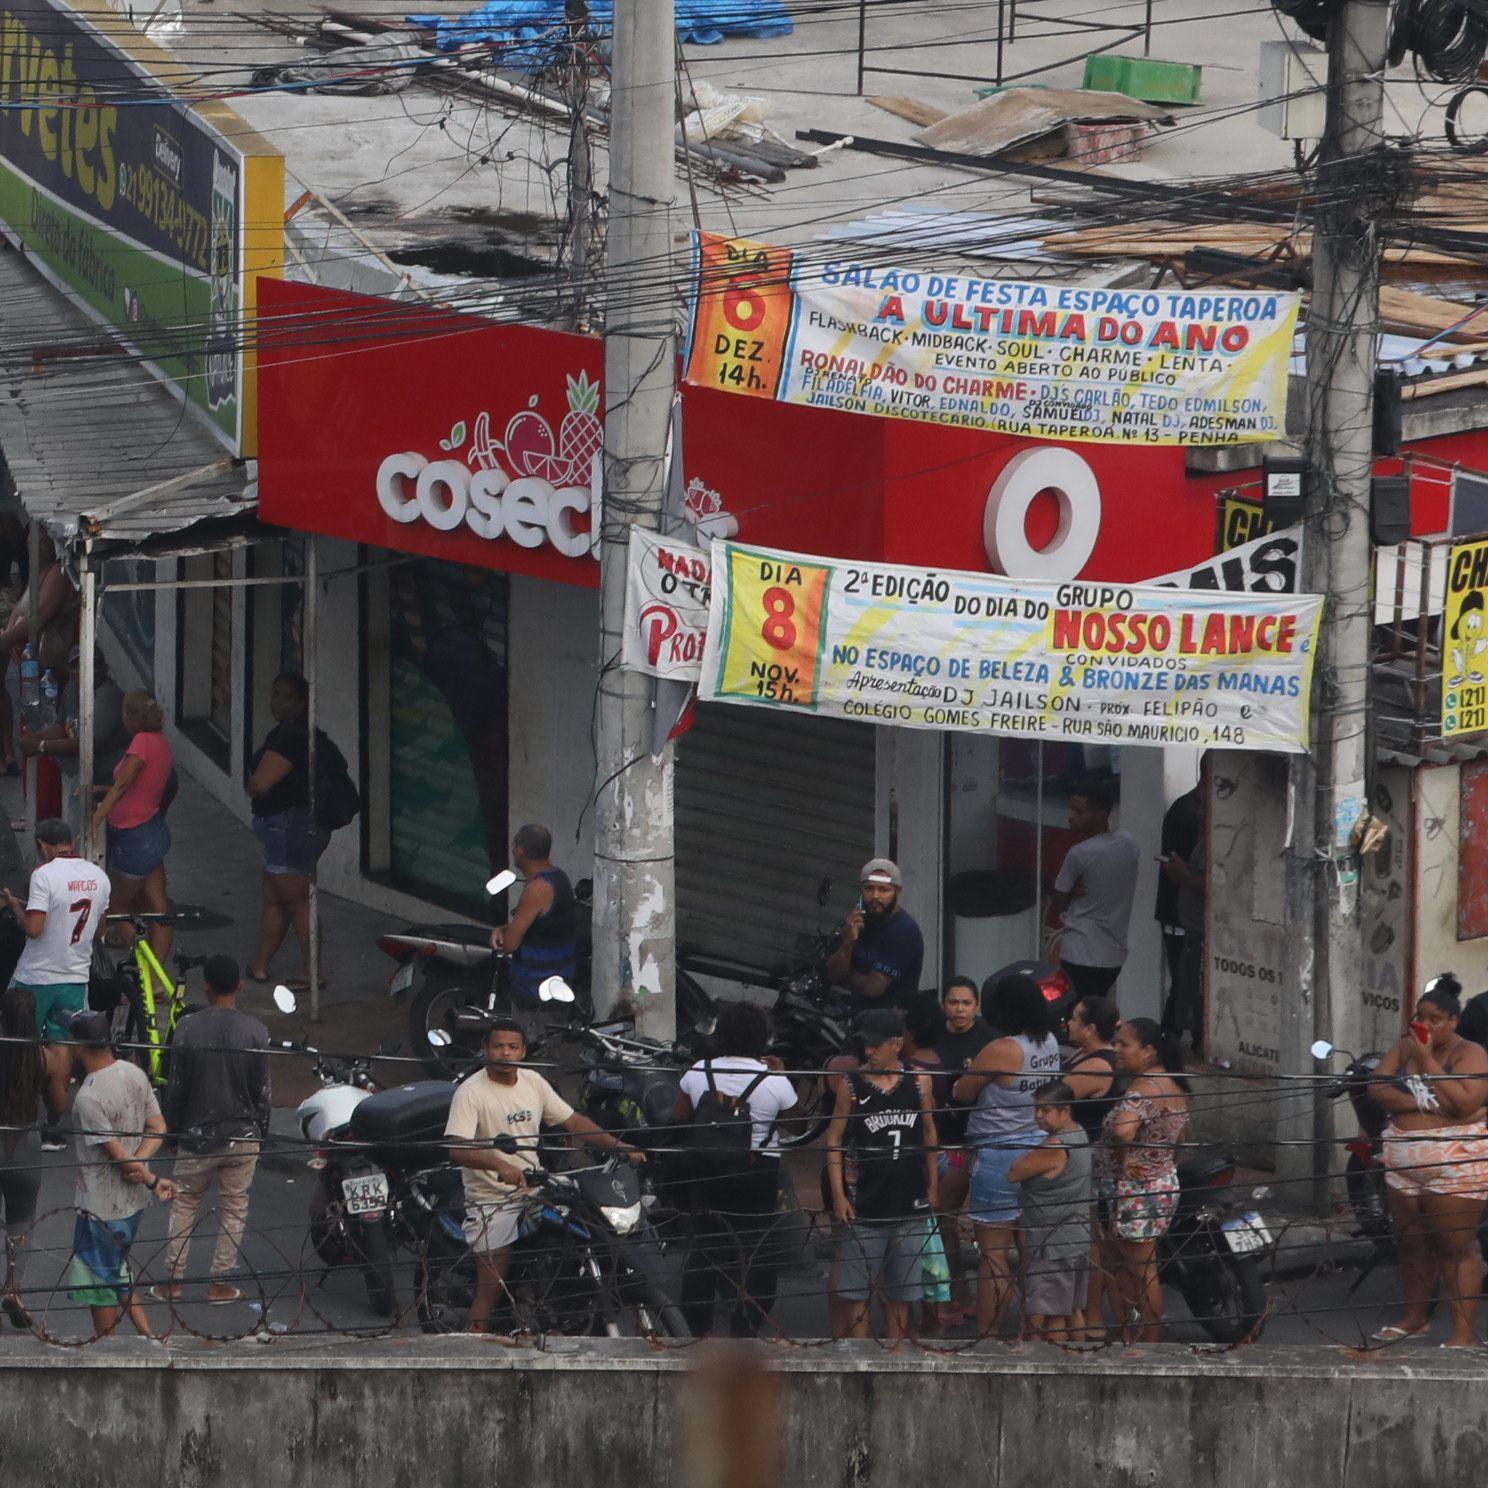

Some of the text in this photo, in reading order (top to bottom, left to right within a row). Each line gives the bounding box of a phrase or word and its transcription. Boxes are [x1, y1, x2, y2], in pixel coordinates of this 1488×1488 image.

[154, 132, 181, 181] Delivery
[723, 272, 767, 332] 6
[821, 262, 920, 294] SALÃO
[926, 277, 960, 299] DE
[967, 280, 1047, 306] FESTA
[1058, 289, 1160, 319] ESPAÇO
[877, 295, 906, 324] A
[1098, 316, 1144, 346] DO
[1148, 322, 1250, 353] ANO
[935, 352, 1176, 386] EVENTO ABERTO AO PÚBLICO
[997, 340, 1044, 359] SOUL
[1060, 346, 1142, 366] CHARME
[1160, 354, 1223, 373] LENTA
[801, 350, 908, 386] RONALDÃO
[914, 373, 937, 391] DO
[943, 376, 1027, 401] CHARME
[1140, 393, 1179, 411] TEDO
[806, 393, 867, 412] JAILSON
[1143, 428, 1159, 443] 13
[1179, 430, 1239, 443] PENHA
[1112, 412, 1158, 426] NATAL
[1189, 416, 1257, 430] ADESMAN
[760, 562, 802, 585] DIA
[874, 573, 950, 605] EDIÇÃO
[954, 594, 981, 615] DO
[987, 598, 1018, 618] DIA
[1025, 601, 1049, 621] DO
[1057, 584, 1134, 611] GRUPO
[762, 587, 796, 651] 8
[1053, 610, 1297, 654] NOSSO LANCE
[833, 644, 1300, 697] NO ESPAÇO DE BELEZA & BRONZE DAS MANAS
[1065, 654, 1187, 670] CONVIDADOS
[982, 689, 1081, 711] JAILSON
[1144, 697, 1218, 718] FELIPÃO
[1240, 705, 1252, 720] e
[1460, 685, 1485, 706] (21)
[924, 708, 980, 728] GOMES
[991, 714, 1046, 732] FREIRE
[1062, 721, 1092, 736] RUA
[1097, 717, 1122, 738] SÃO
[1460, 708, 1485, 729] (21)
[69, 898, 92, 946] 7
[1214, 956, 1276, 982] TODOS OS
[887, 1130, 901, 1160] 7
